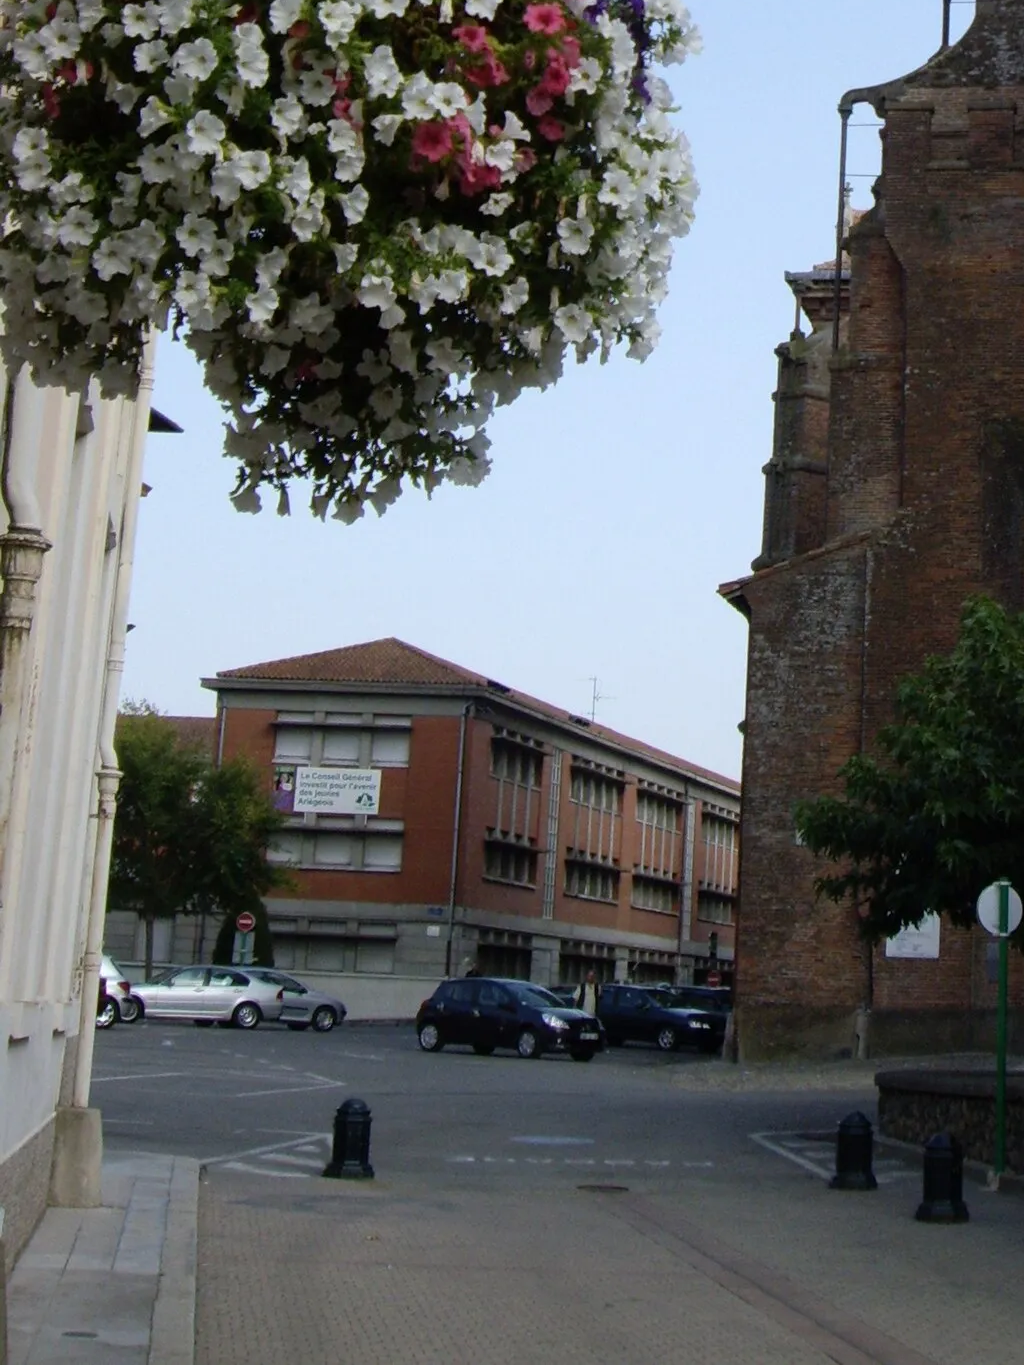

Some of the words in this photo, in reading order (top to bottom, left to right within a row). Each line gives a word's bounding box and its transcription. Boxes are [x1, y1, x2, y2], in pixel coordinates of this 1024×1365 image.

[312, 772, 340, 780] Conseil
[342, 773, 372, 782] Général
[314, 789, 340, 798] jeunes
